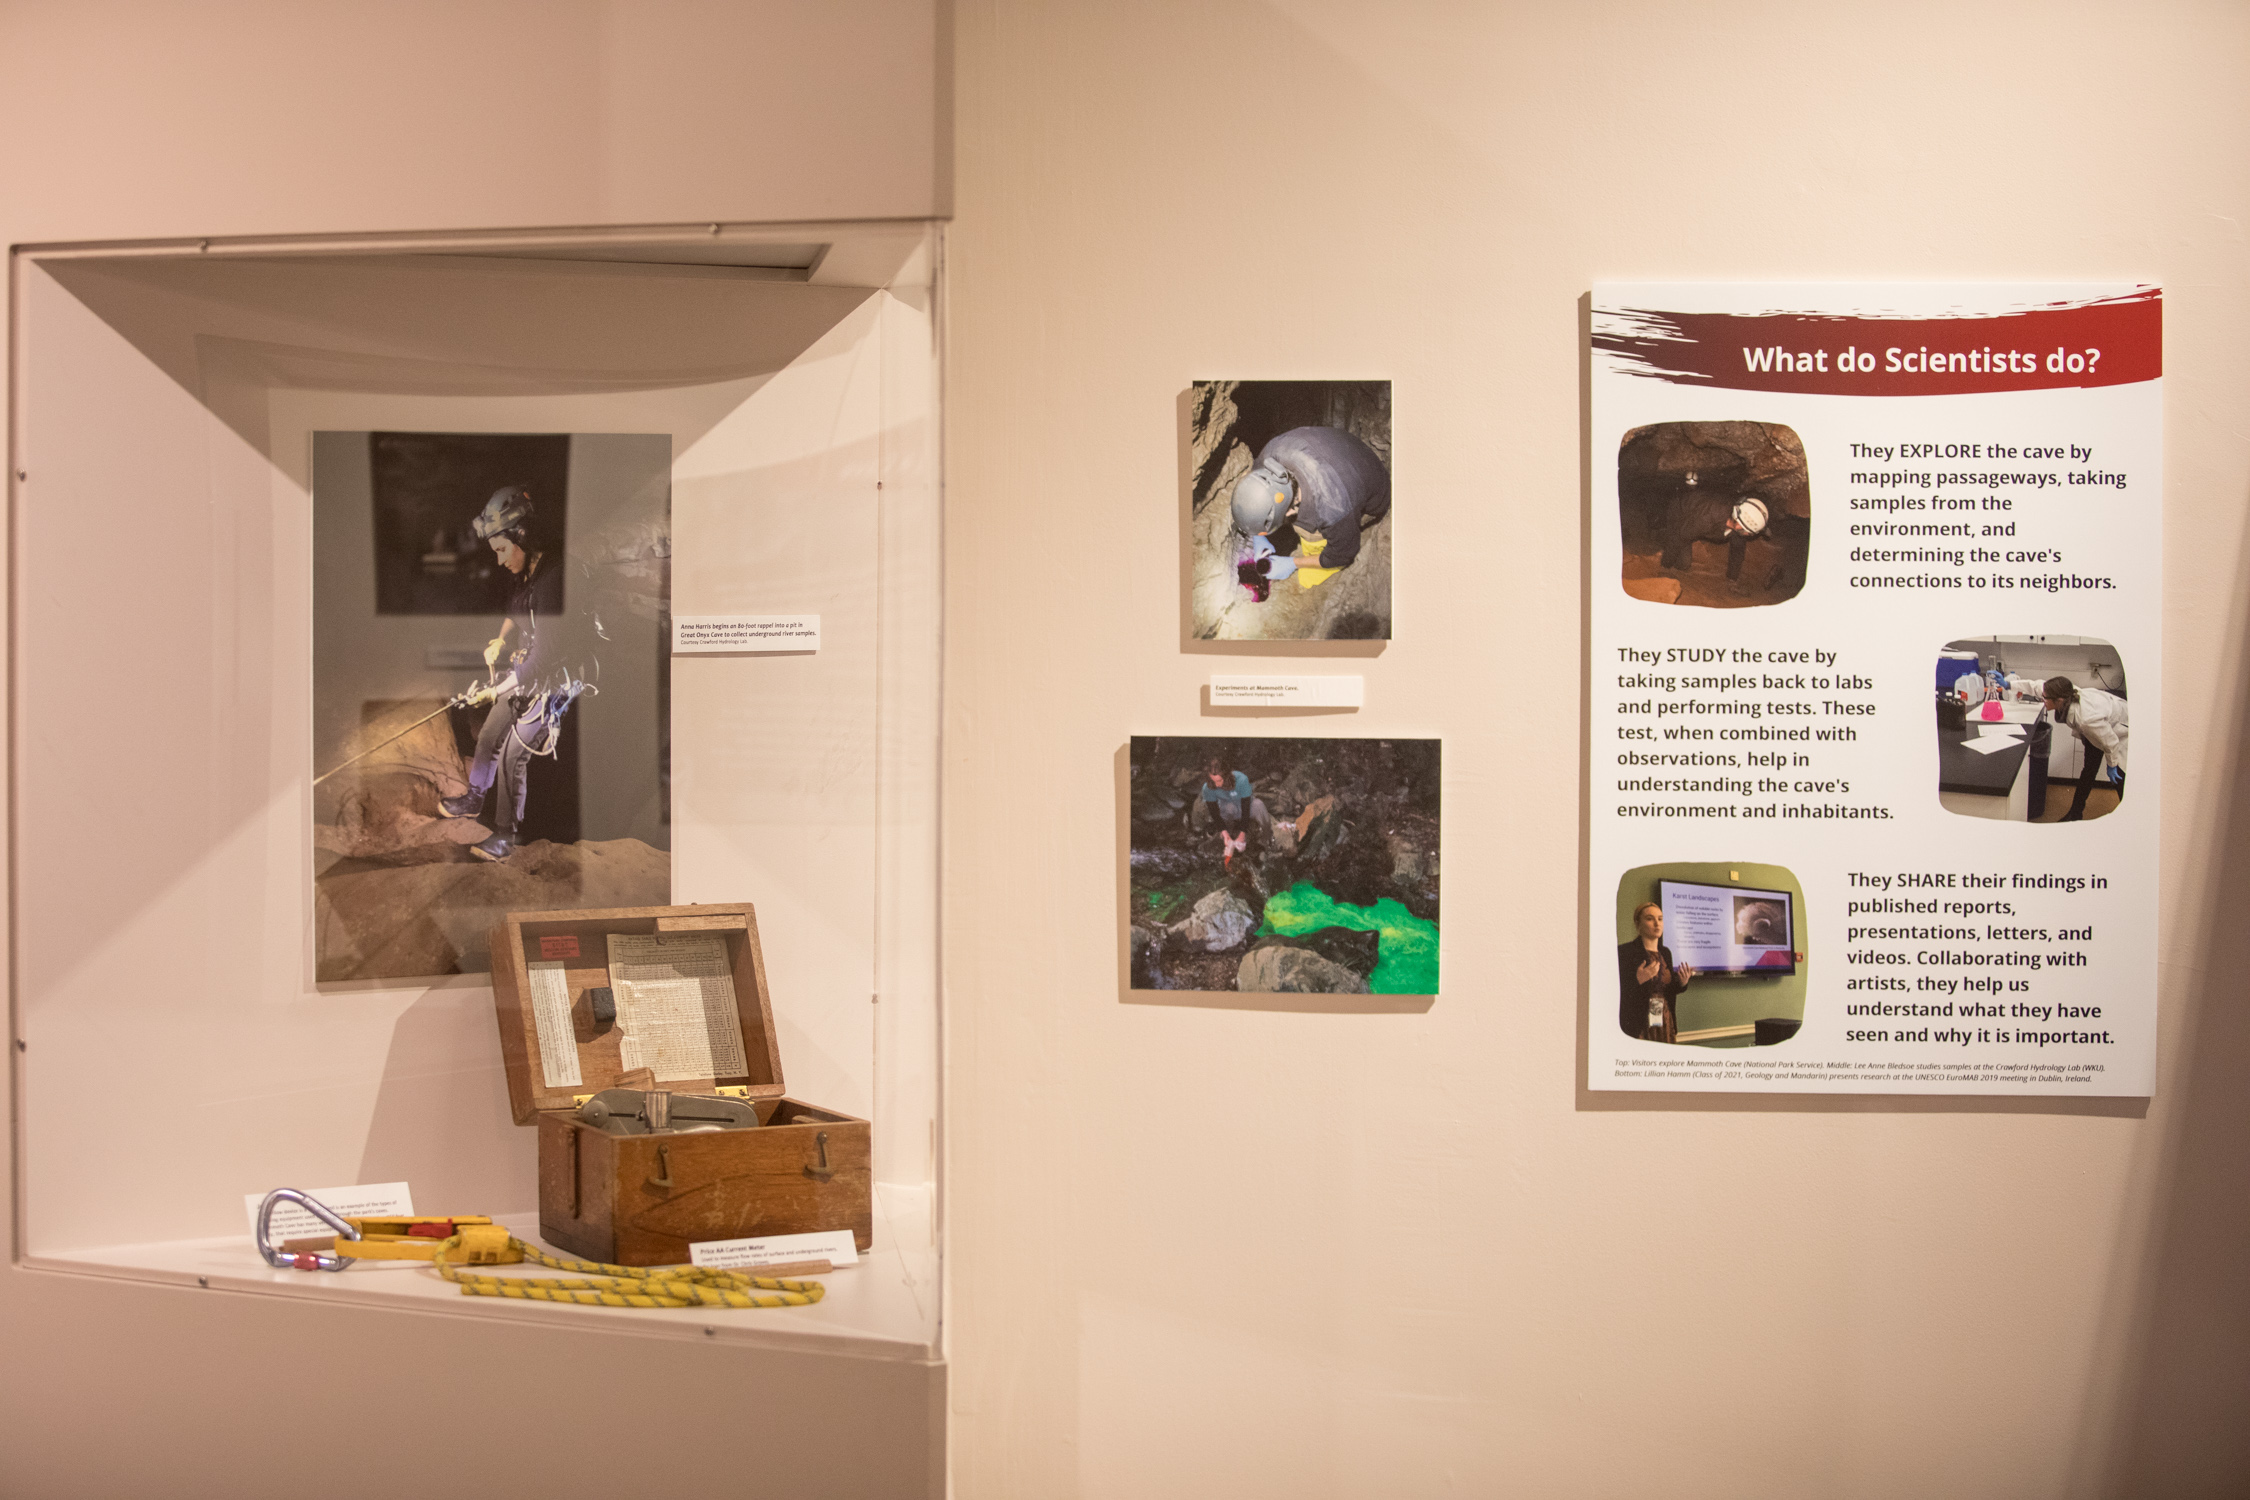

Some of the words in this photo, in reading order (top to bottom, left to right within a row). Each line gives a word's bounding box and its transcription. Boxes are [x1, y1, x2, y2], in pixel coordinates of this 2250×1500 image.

[1742, 345, 1828, 372] What
[1837, 346, 1875, 372] do
[1885, 346, 2036, 373] Scientists
[2046, 346, 2100, 373] do?
[1850, 443, 1894, 462] They
[1900, 444, 1980, 458] EXPLORE
[1987, 443, 2017, 458] the
[2023, 447, 2064, 458] cave
[2070, 443, 2091, 463] by
[1851, 469, 1931, 488] mapping
[1937, 472, 2061, 489] passageways,
[2067, 470, 2126, 489] taking
[1850, 494, 1925, 514] samples
[1931, 495, 1975, 510] from
[1981, 495, 2012, 510] the
[1850, 520, 1975, 538] environment,
[1981, 521, 2015, 536] and
[1850, 546, 1964, 566] determining
[1969, 547, 2000, 562] the
[2005, 548, 2061, 562] cave's
[1850, 572, 1961, 587] connections
[1967, 575, 1986, 588] to
[1992, 573, 2014, 588] its
[2020, 573, 2116, 593] neighbors.
[695, 631, 709, 639] Onyx
[748, 630, 781, 638] underground
[1617, 647, 1661, 666] They
[1667, 648, 1726, 662] STUDY
[1732, 648, 1762, 662] the
[1768, 652, 1809, 663] cave
[1815, 648, 1836, 667] by
[1617, 673, 1676, 692] taking
[1681, 673, 1756, 692] samples
[1763, 674, 1805, 688] back
[1811, 676, 1829, 689] to
[1836, 674, 1872, 689] labs
[1617, 699, 1650, 713] and
[1658, 699, 1761, 718] performing
[1766, 701, 1816, 714] tests.
[1822, 700, 1875, 715] These
[1617, 726, 1657, 741] test,
[1663, 725, 1713, 739] when
[1719, 725, 1809, 740] combined
[1815, 726, 1856, 740] with
[1617, 750, 1740, 768] observations,
[1748, 751, 1786, 770] help
[1793, 752, 1809, 766] in
[1617, 776, 1752, 796] understanding
[1758, 777, 1788, 792] the
[1794, 778, 1849, 792] cave's
[1617, 802, 1736, 817] environment
[1742, 803, 1775, 817] and
[1782, 803, 1893, 819] inhabitants.
[1847, 872, 1891, 891] They
[1897, 873, 1956, 887] SHARE
[1961, 873, 2006, 888] their
[2012, 873, 2085, 893] findings
[2091, 874, 2107, 888] in
[1672, 892, 1688, 900] Karst
[1689, 894, 1720, 903] Landscapes
[1848, 898, 1937, 917] published
[1944, 901, 2015, 918] reports,
[1848, 924, 1980, 943] presentations,
[1987, 925, 2051, 942] letters,
[2058, 925, 2091, 940] and
[1847, 949, 1910, 964] videos.
[1917, 950, 2041, 970] Collaborating
[2046, 951, 2086, 966] with
[1847, 975, 1910, 992] artists,
[1916, 976, 1958, 995] they
[1963, 976, 2002, 995] help
[2009, 980, 2029, 991] us
[1847, 1001, 1952, 1016] understand
[1958, 1002, 2005, 1017] what
[2011, 1002, 2052, 1021] they
[2058, 1002, 2101, 1018] have
[1846, 1030, 1888, 1041] seen
[1894, 1027, 1927, 1041] and
[1934, 1027, 1972, 1046] why
[1977, 1028, 1990, 1042] it
[1996, 1028, 2009, 1042] is
[2016, 1028, 2114, 1048] important.
[1615, 1059, 1630, 1067] Top:
[1796, 1061, 1824, 1069] Service).
[1942, 1063, 1971, 1071] samples
[1995, 1063, 2029, 1072] Crawford
[2030, 1063, 2066, 1072] Hydrology
[2081, 1064, 2105, 1072] (WKU).
[1692, 1070, 1712, 1078] (Class
[1714, 1071, 1722, 1079] of
[1745, 1072, 1773, 1080] Geology
[1790, 1072, 1827, 1080] Mandarin)
[1828, 1073, 1858, 1081] presents
[1946, 1073, 1978, 1081] EuroMAB
[1999, 1075, 2028, 1083] meeting
[2038, 1074, 2063, 1082] Dublin,
[700, 1247, 715, 1255] Price
